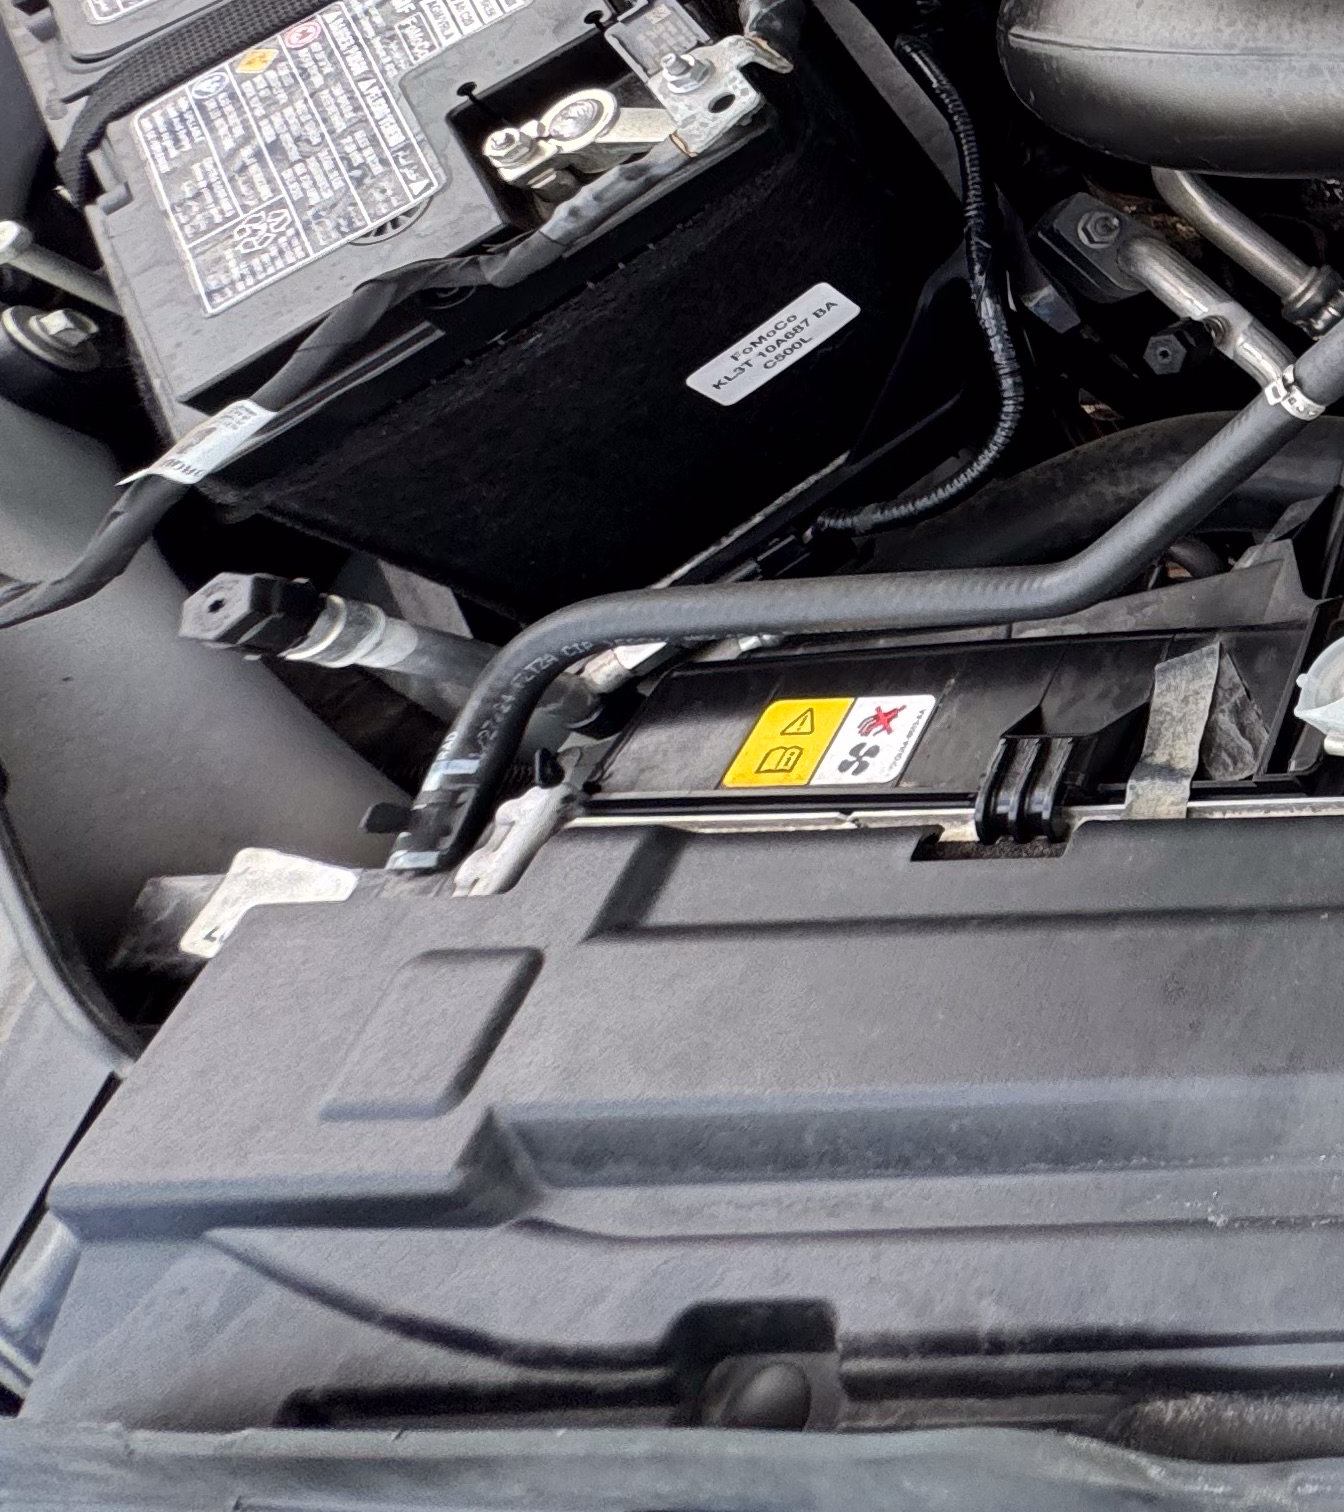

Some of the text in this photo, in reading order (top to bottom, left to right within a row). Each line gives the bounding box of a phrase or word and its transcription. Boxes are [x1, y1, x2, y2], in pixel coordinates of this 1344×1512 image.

[394, 15, 436, 61] FoMoCo
[712, 299, 838, 390] KL3T 10A687 BA
[729, 312, 798, 362] FoMoCo
[762, 333, 813, 371] C500L
